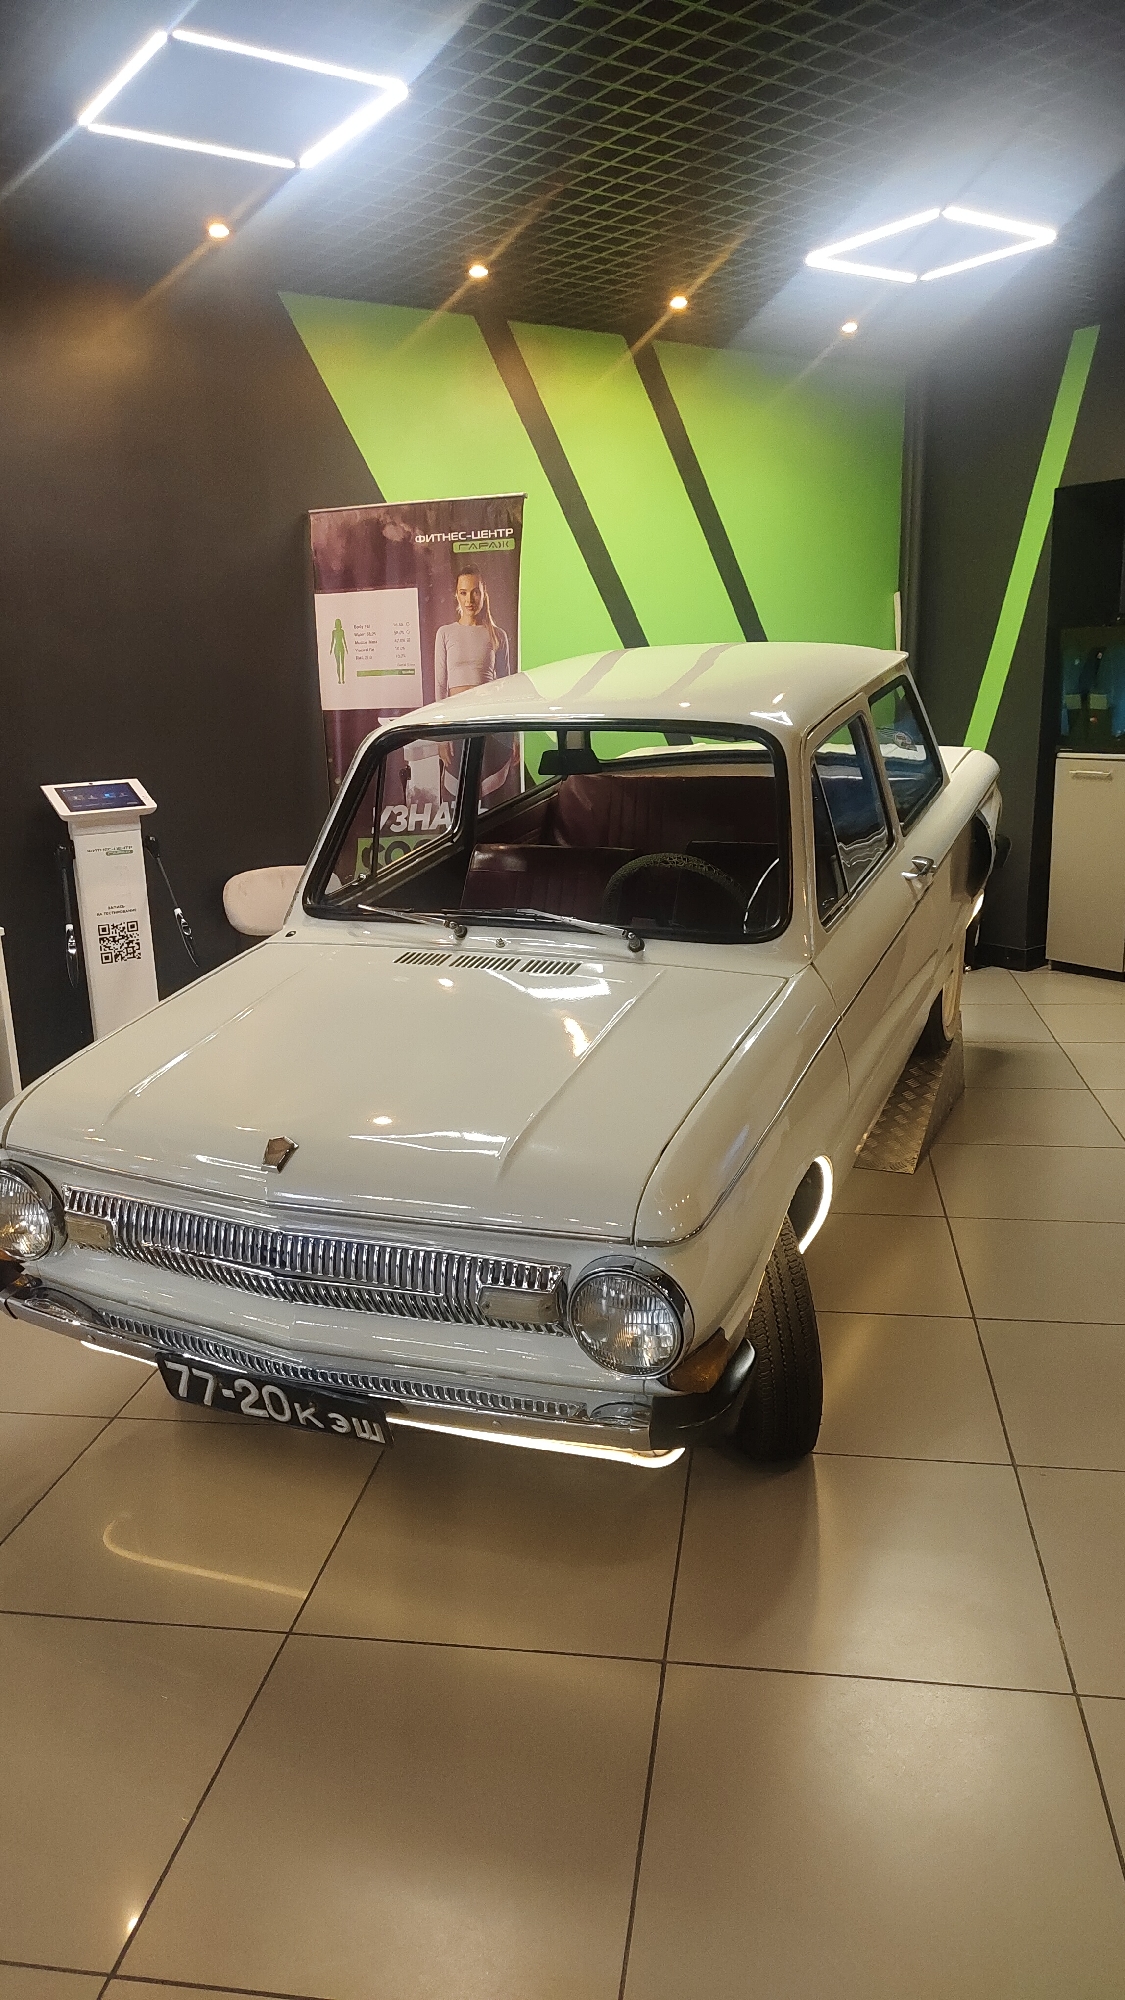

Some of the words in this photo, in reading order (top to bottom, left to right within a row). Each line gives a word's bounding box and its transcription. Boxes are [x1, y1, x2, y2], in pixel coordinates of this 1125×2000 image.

[414, 527, 514, 544] ФИТНЕС-ЦЕНТР
[458, 541, 510, 551] ГАРАЖ
[371, 800, 490, 835] УЗНА
